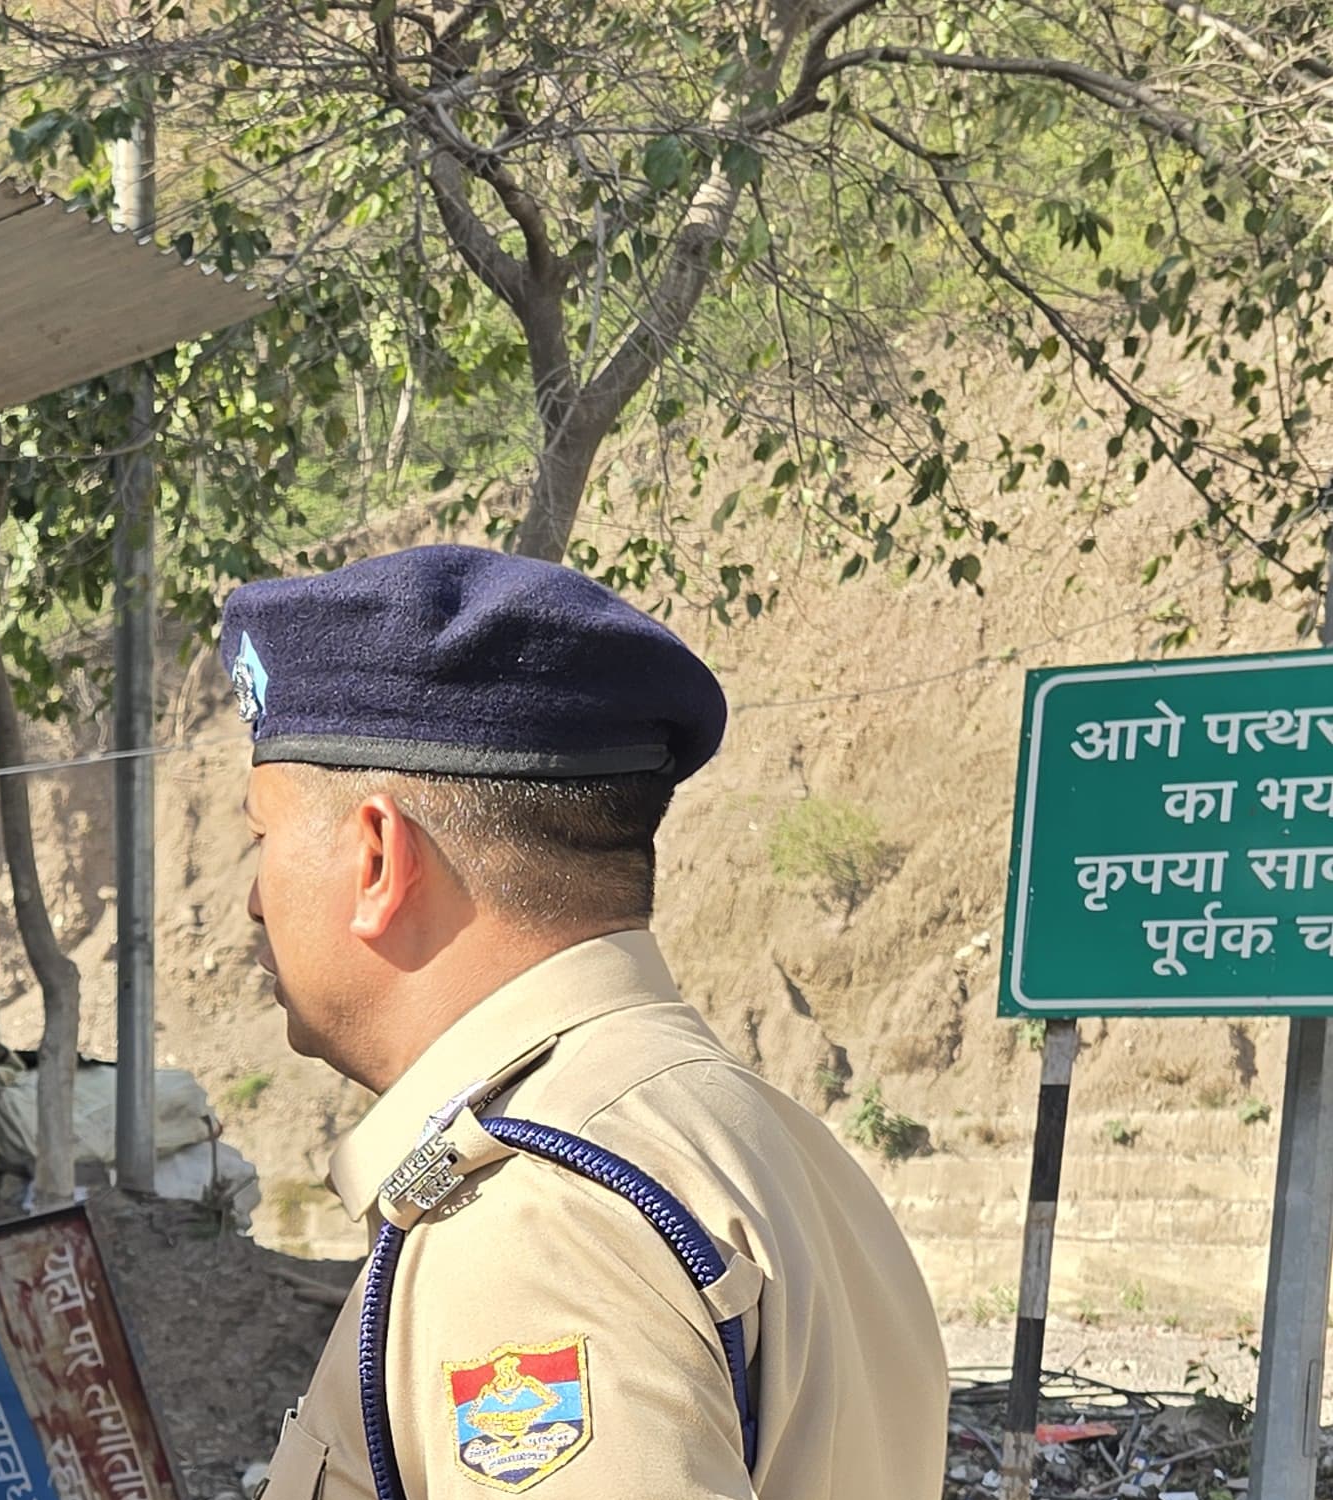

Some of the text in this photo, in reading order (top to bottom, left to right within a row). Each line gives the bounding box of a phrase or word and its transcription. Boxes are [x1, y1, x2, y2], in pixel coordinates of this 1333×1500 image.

[1070, 700, 1186, 761] आगे
[1162, 776, 1333, 824] का भय
[1075, 851, 1229, 911] कृपया
[1142, 901, 1277, 976] पूर्वक
[64, 1319, 105, 1378] पर
